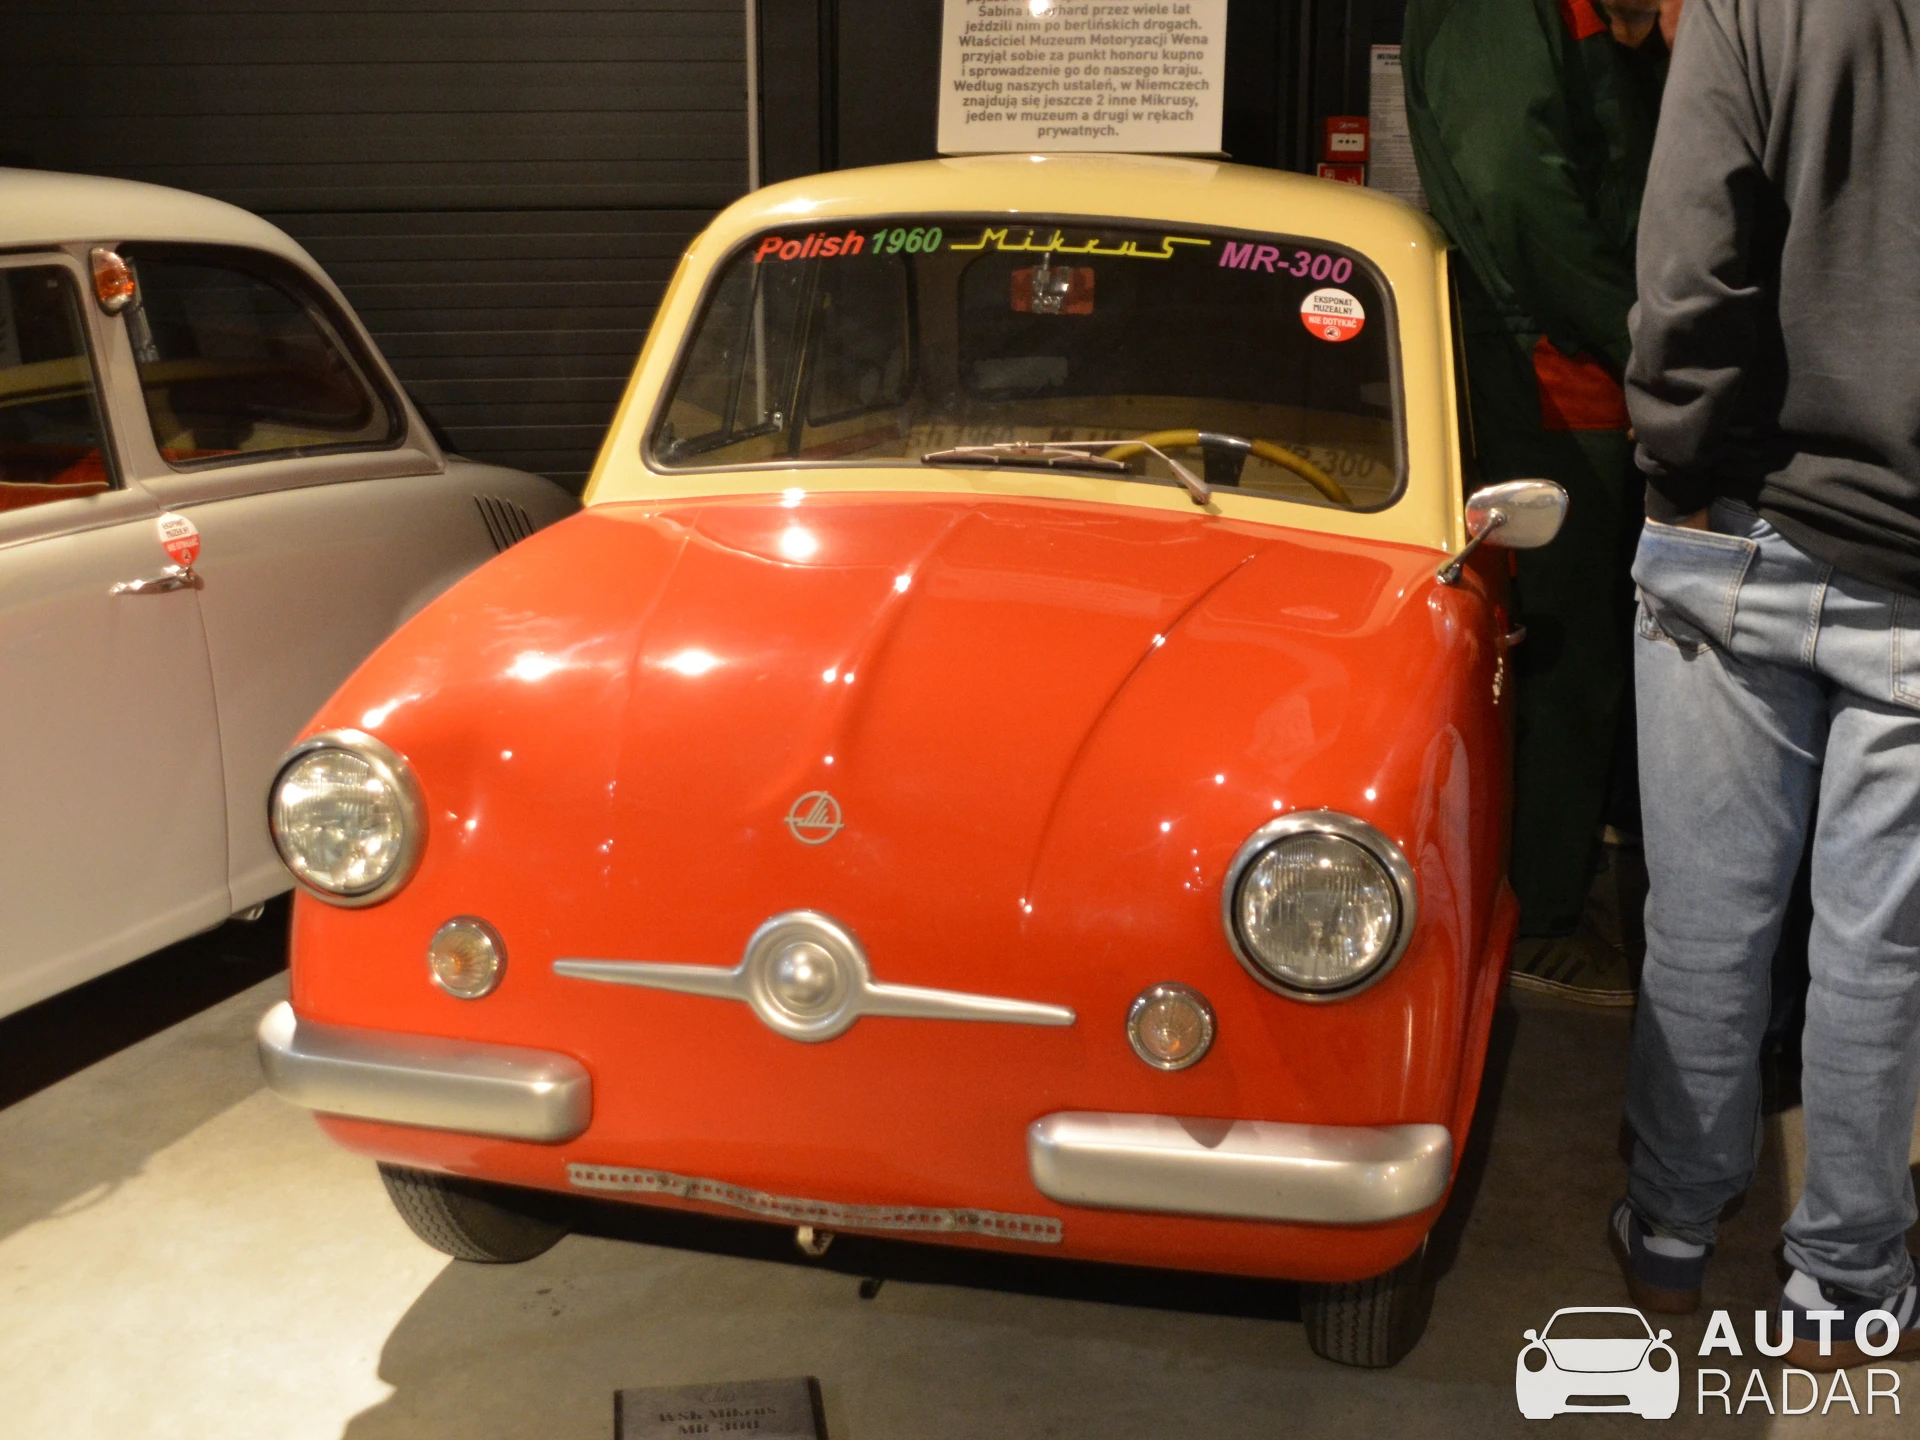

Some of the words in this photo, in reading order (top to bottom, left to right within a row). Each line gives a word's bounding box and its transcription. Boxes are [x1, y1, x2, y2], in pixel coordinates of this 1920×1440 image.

[978, 5, 1022, 17] Sabina
[1034, 5, 1088, 17] erhard
[1092, 6, 1129, 17] przez
[1133, 3, 1169, 15] wiele
[1173, 4, 1191, 15] lat
[965, 20, 1012, 34] jeździli
[1016, 20, 1041, 31] nim
[1045, 21, 1060, 33] po
[1064, 18, 1140, 31] berlińskich
[1143, 18, 1202, 33] drogach.
[958, 35, 1025, 47] Właściciel
[1030, 34, 1086, 46] Muzeum
[1090, 33, 1167, 47] Motoryzacji
[1171, 33, 1209, 45] Wena
[961, 50, 1007, 64] przyjął
[1010, 50, 1045, 61] sobie
[1049, 51, 1064, 61] za
[1068, 49, 1106, 62] punkt
[1110, 49, 1158, 60] honoru
[1162, 48, 1204, 62] kupno
[968, 65, 1060, 79] sprowadzenie
[1064, 66, 1080, 78] go
[1084, 64, 1100, 76] do
[1104, 65, 1159, 78] naszego
[1163, 63, 1202, 77] kraju.
[953, 80, 1003, 94] Według
[1007, 79, 1059, 93] naszych
[1063, 78, 1117, 92] ustaleń,
[1120, 81, 1132, 90] w
[1135, 79, 1210, 91] Niemczech
[962, 95, 1018, 109] znajdują
[1021, 94, 1041, 108] się
[1043, 94, 1093, 108] jeszcze
[1096, 94, 1105, 106] 2
[1108, 94, 1137, 106] inne
[1141, 94, 1198, 108] Mikrusy,
[965, 110, 1002, 124] jeden
[1006, 112, 1017, 121] w
[1020, 111, 1078, 121] muzeum
[1081, 111, 1089, 121] a
[1093, 109, 1129, 123] drugi
[1132, 111, 1144, 121] w
[1147, 109, 1194, 124] rękach
[1037, 124, 1119, 139] prywatnych.
[754, 228, 864, 264] Polish
[870, 226, 943, 255] 1960
[1218, 240, 1353, 284] MR-300
[1313, 295, 1353, 307] EKSPONAT
[1312, 303, 1353, 315] MUZEALNY
[1308, 316, 1322, 325] NIE
[1322, 316, 1357, 328] DOTYKAĆ
